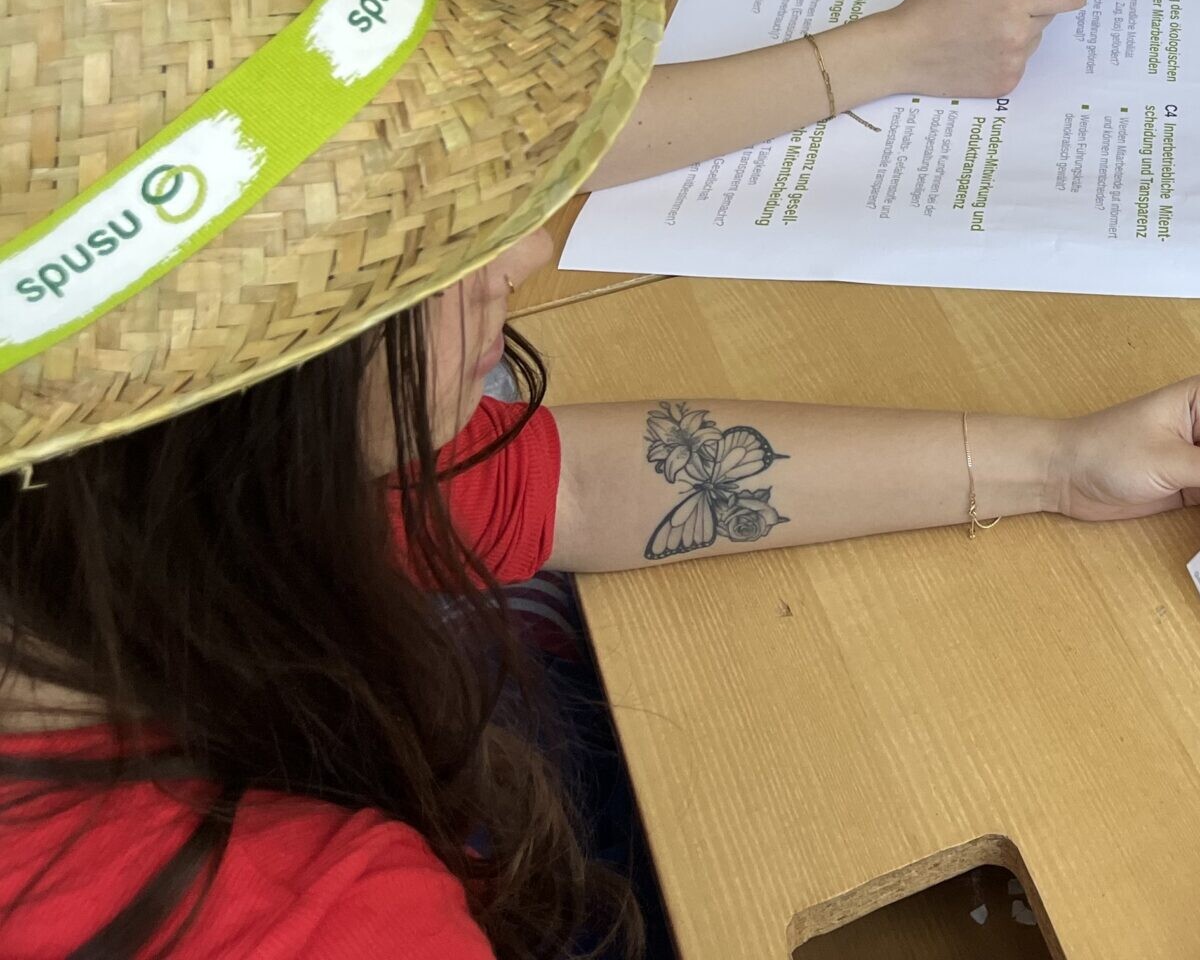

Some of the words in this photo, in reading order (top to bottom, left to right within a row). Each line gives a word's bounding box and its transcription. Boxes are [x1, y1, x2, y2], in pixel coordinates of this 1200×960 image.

[1170, 5, 1182, 20] des
[1149, 9, 1164, 74] Mitarbeitenden
[1166, 23, 1181, 82] ökologischen
[907, 109, 921, 125] Sind
[944, 111, 960, 137] Können
[995, 99, 1010, 111] D4
[1104, 116, 1113, 129] und
[1164, 105, 1177, 117] C4
[801, 120, 830, 171] ansparenz
[879, 108, 905, 167] Preisbestandteile
[919, 110, 944, 171] Produktgestaltung
[940, 139, 952, 153] sich
[1060, 113, 1075, 160] demokratisch
[1078, 115, 1090, 141] Werden
[1101, 131, 1112, 156] können
[1117, 117, 1129, 143] Werden
[1139, 105, 1157, 155] scheidung
[729, 151, 754, 190] transparent
[749, 146, 771, 185] Tätigkeiten
[954, 117, 986, 209] Produkttransparenz
[972, 117, 1006, 208] Kunden-Mitwirkung
[1141, 158, 1154, 176] und
[1160, 123, 1176, 199] Innerbetriebliche
[666, 174, 694, 225] mitbestimmen?
[756, 145, 803, 226] Mitentscheidung
[794, 173, 809, 190] und
[784, 193, 803, 225] gesell-
[971, 211, 985, 232] und
[1108, 204, 1121, 239] informiert
[1135, 178, 1153, 238] Transparenz
[1157, 205, 1172, 242] Mitent-
[17, 209, 143, 303] spusu
